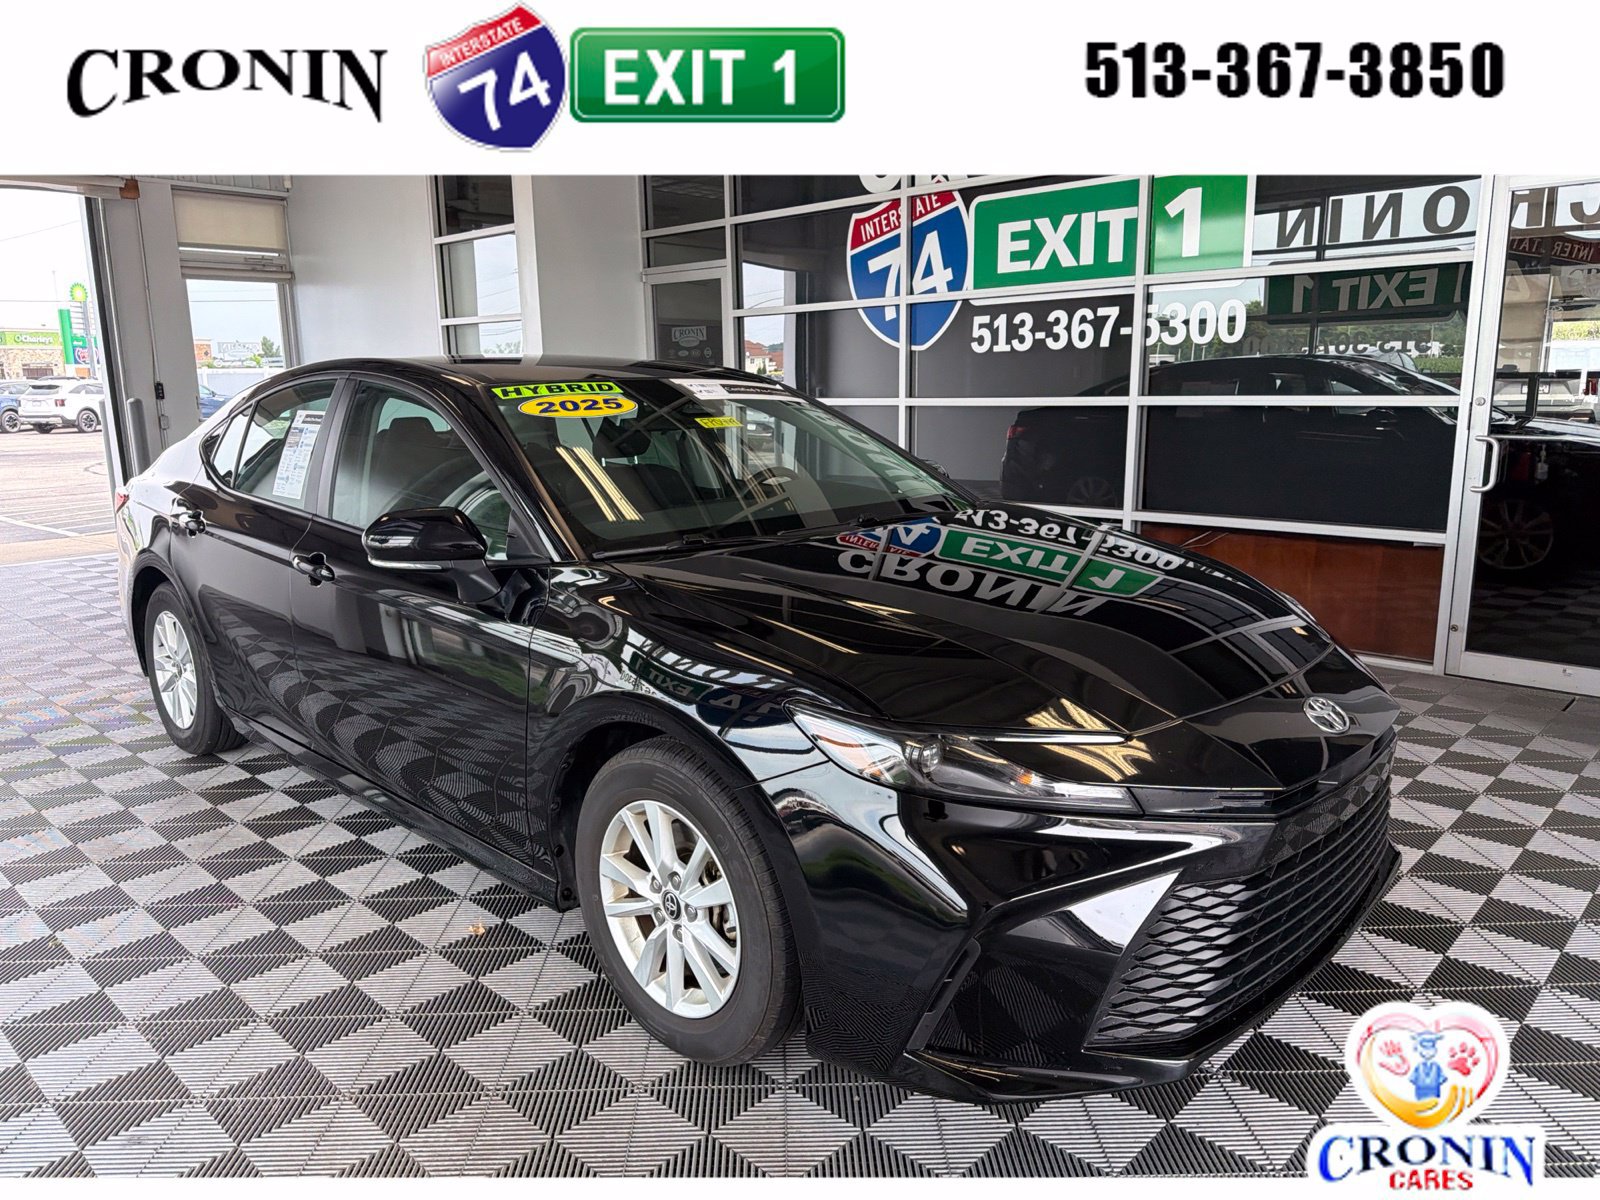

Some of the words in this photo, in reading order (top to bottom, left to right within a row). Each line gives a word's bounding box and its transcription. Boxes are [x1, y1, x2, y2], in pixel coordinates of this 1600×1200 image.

[997, 206, 1138, 274] EXIT
[1164, 186, 1203, 258] 1
[867, 229, 954, 322] 74
[501, 383, 614, 398] HYBRID
[536, 398, 623, 414] 2025
